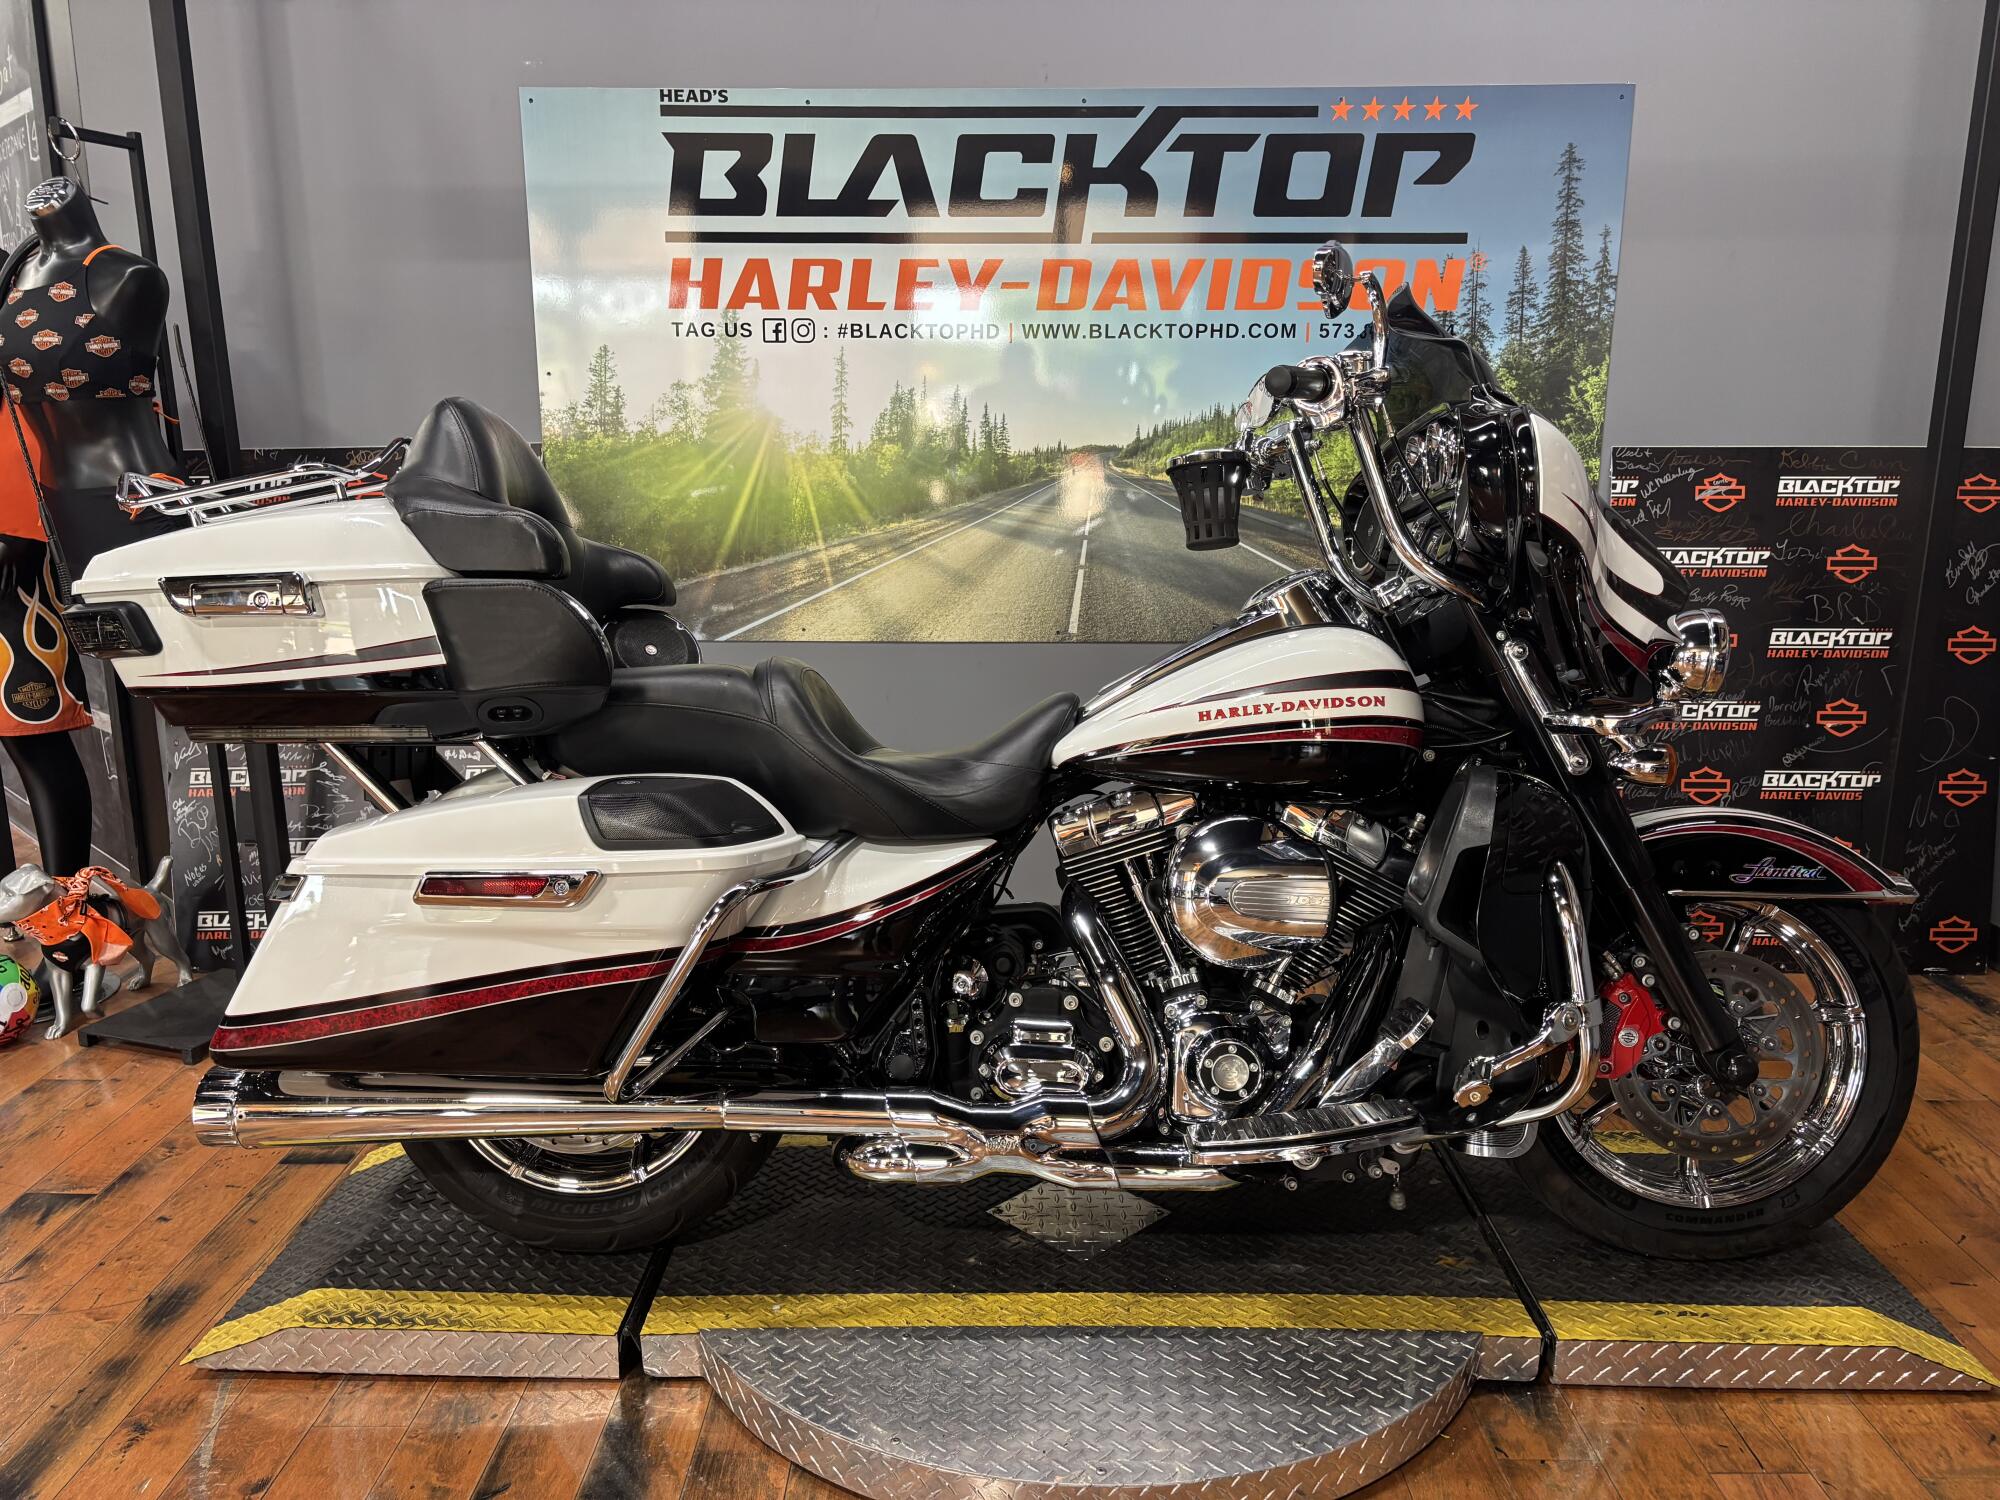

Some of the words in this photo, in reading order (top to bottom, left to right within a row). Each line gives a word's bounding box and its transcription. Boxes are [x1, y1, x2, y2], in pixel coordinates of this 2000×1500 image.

[659, 88, 729, 103] HEAD'S
[661, 130, 1476, 220] BLACKTOP
[671, 322, 717, 338] TAG
[724, 322, 753, 339] US
[837, 322, 1000, 340] #BLACKTOPHD
[1022, 322, 1297, 340] WWW.BLACKTOPHD.COM
[1777, 477, 1901, 495] BLACKTOP
[1776, 498, 1897, 507] HARLEY-DAVIDSON
[1769, 630, 1893, 647] BLACKTOP
[1767, 650, 1889, 659] HARLEY-DAVIDSON
[1198, 695, 1386, 722] HARLEY-DAVIDSON
[1762, 773, 1882, 790] BLACKTOP
[1729, 857, 1826, 884] Limited
